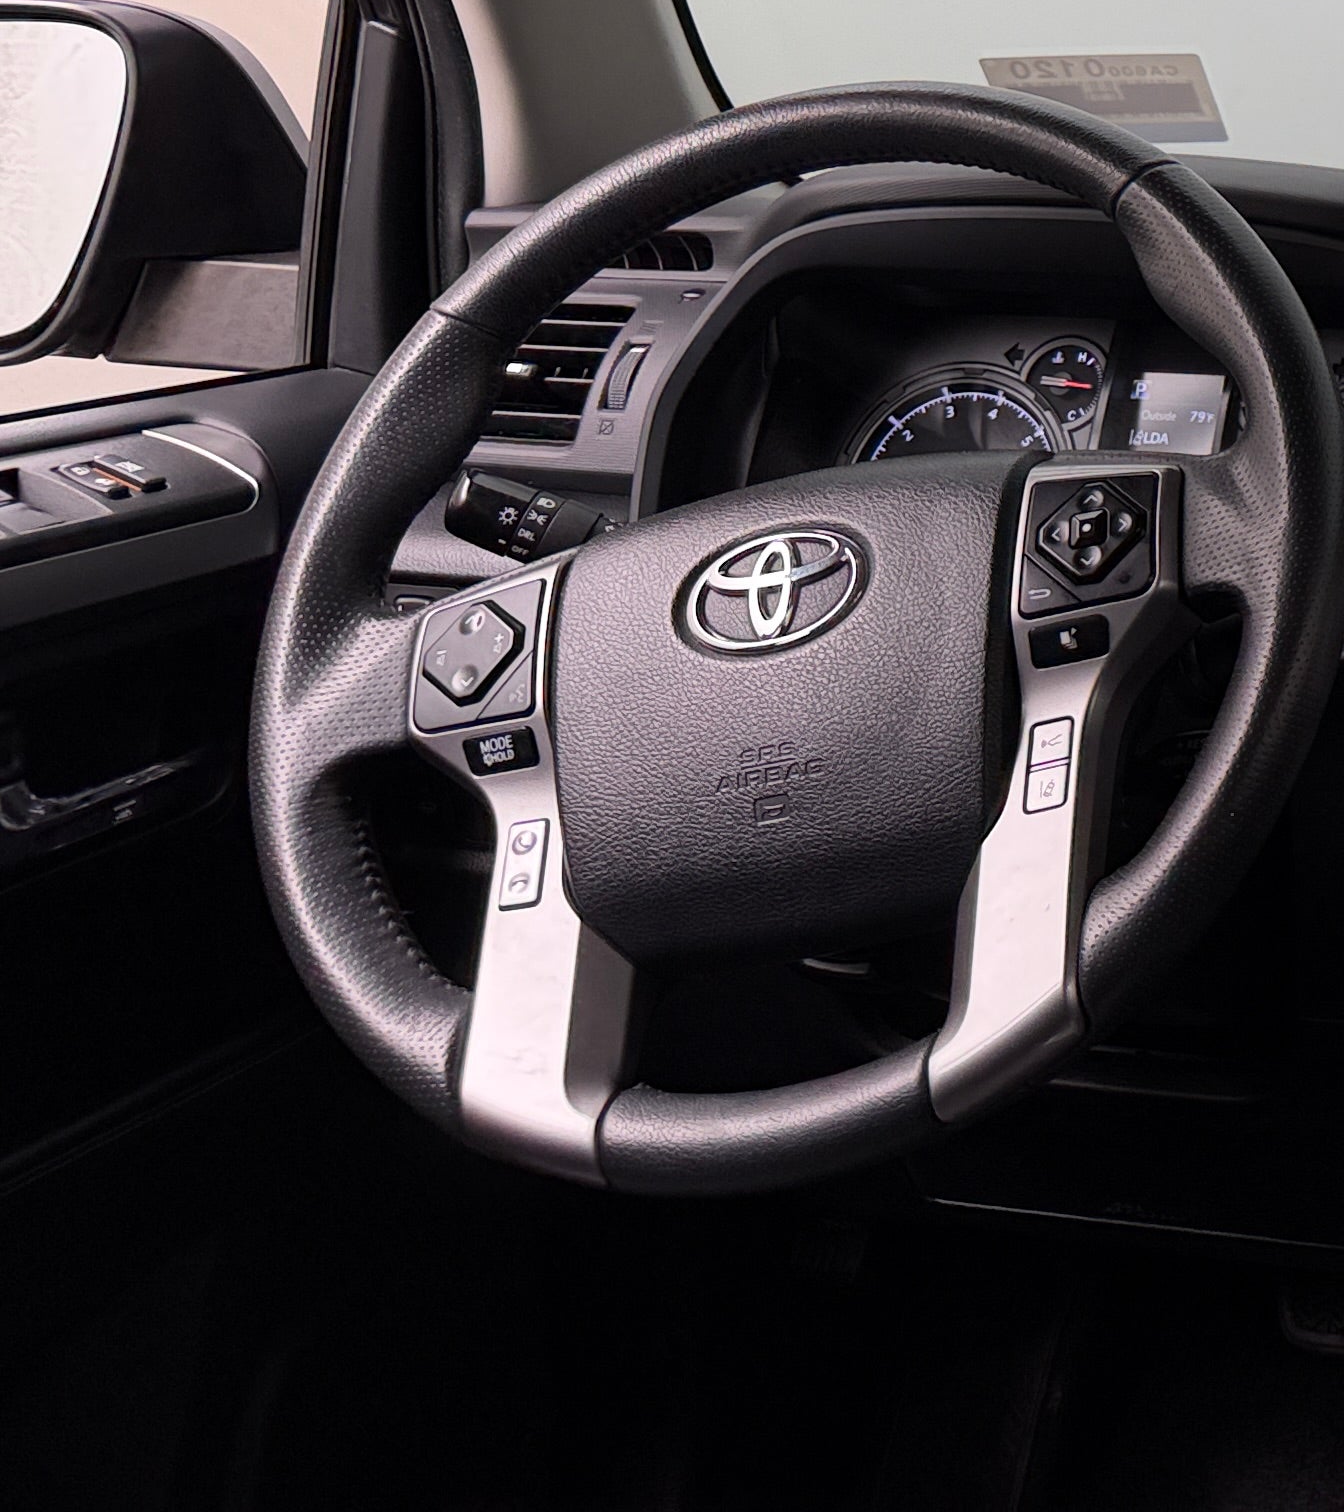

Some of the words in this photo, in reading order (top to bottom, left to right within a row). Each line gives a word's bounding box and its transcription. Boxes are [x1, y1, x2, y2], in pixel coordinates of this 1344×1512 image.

[945, 405, 956, 419] 3
[986, 408, 999, 421] 4
[902, 429, 915, 442] 2
[1021, 435, 1036, 448] 5
[1143, 431, 1169, 445] LDA
[479, 734, 514, 754] MODE
[491, 749, 515, 763] HOLD
